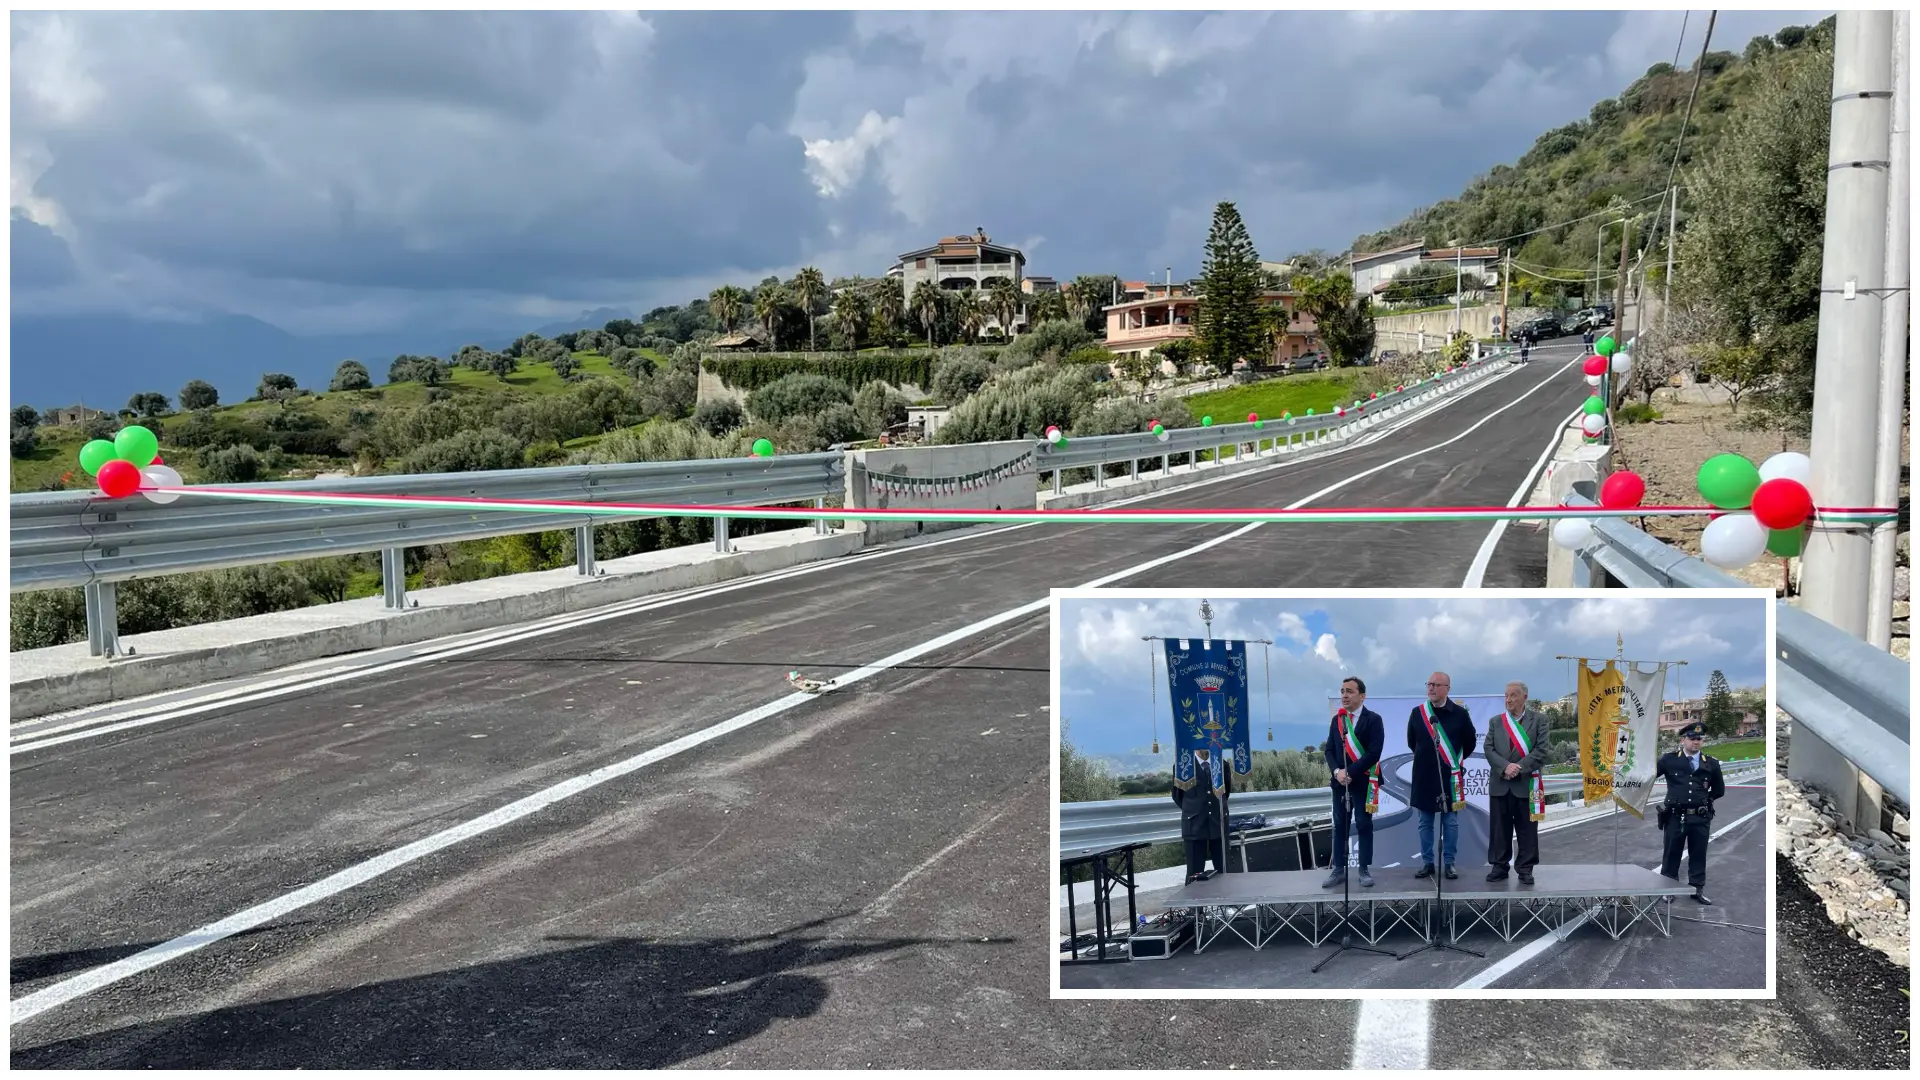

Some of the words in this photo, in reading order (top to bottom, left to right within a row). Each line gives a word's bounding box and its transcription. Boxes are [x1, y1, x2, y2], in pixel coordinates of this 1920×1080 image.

[1180, 662, 1203, 676] COMUNE
[1617, 697, 1626, 705] DI
[1611, 780, 1642, 789] CALABRIA
